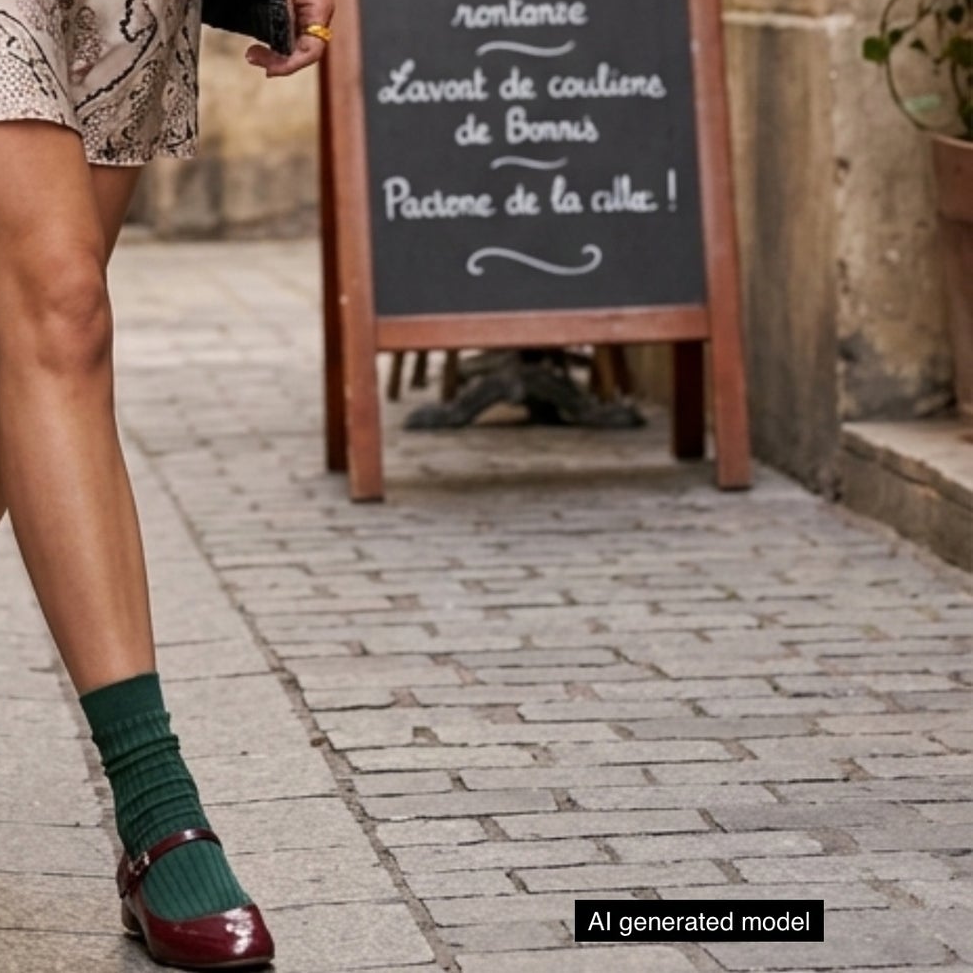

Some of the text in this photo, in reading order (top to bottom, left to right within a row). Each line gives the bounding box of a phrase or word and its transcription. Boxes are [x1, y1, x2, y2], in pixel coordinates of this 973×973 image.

[499, 66, 537, 100] de
[455, 114, 492, 145] de
[505, 184, 540, 215] de
[550, 175, 583, 213] la
